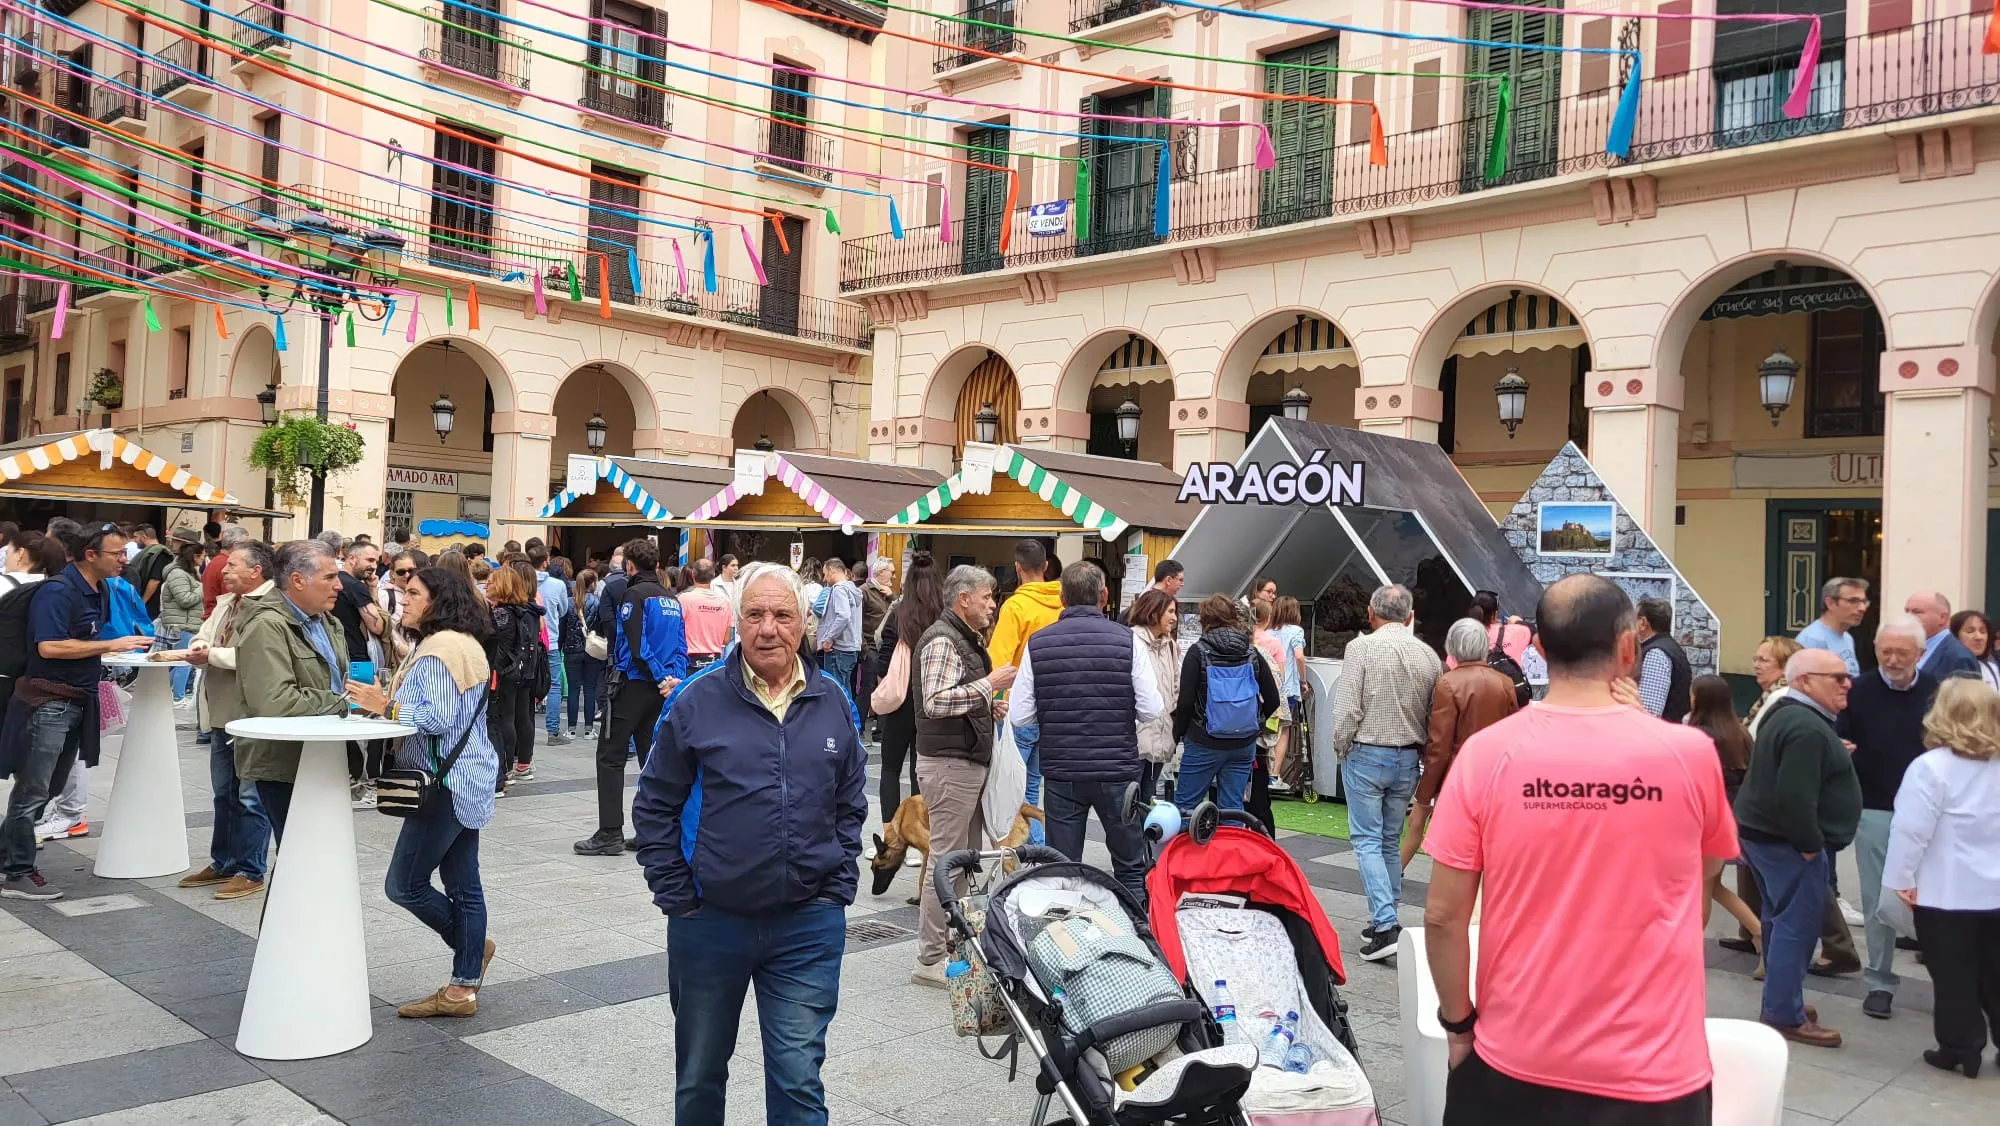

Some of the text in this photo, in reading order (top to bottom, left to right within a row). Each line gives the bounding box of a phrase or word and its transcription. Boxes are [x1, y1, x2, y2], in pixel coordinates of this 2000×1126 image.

[1040, 216, 1064, 228] VENDE
[1711, 285, 1869, 318] pruebe sus especialida
[387, 468, 454, 486] AMADO ARA
[1176, 449, 1365, 505] ARAGÓN
[1836, 453, 1884, 483] ULT
[1523, 801, 1608, 811] SUPERMERCADOS
